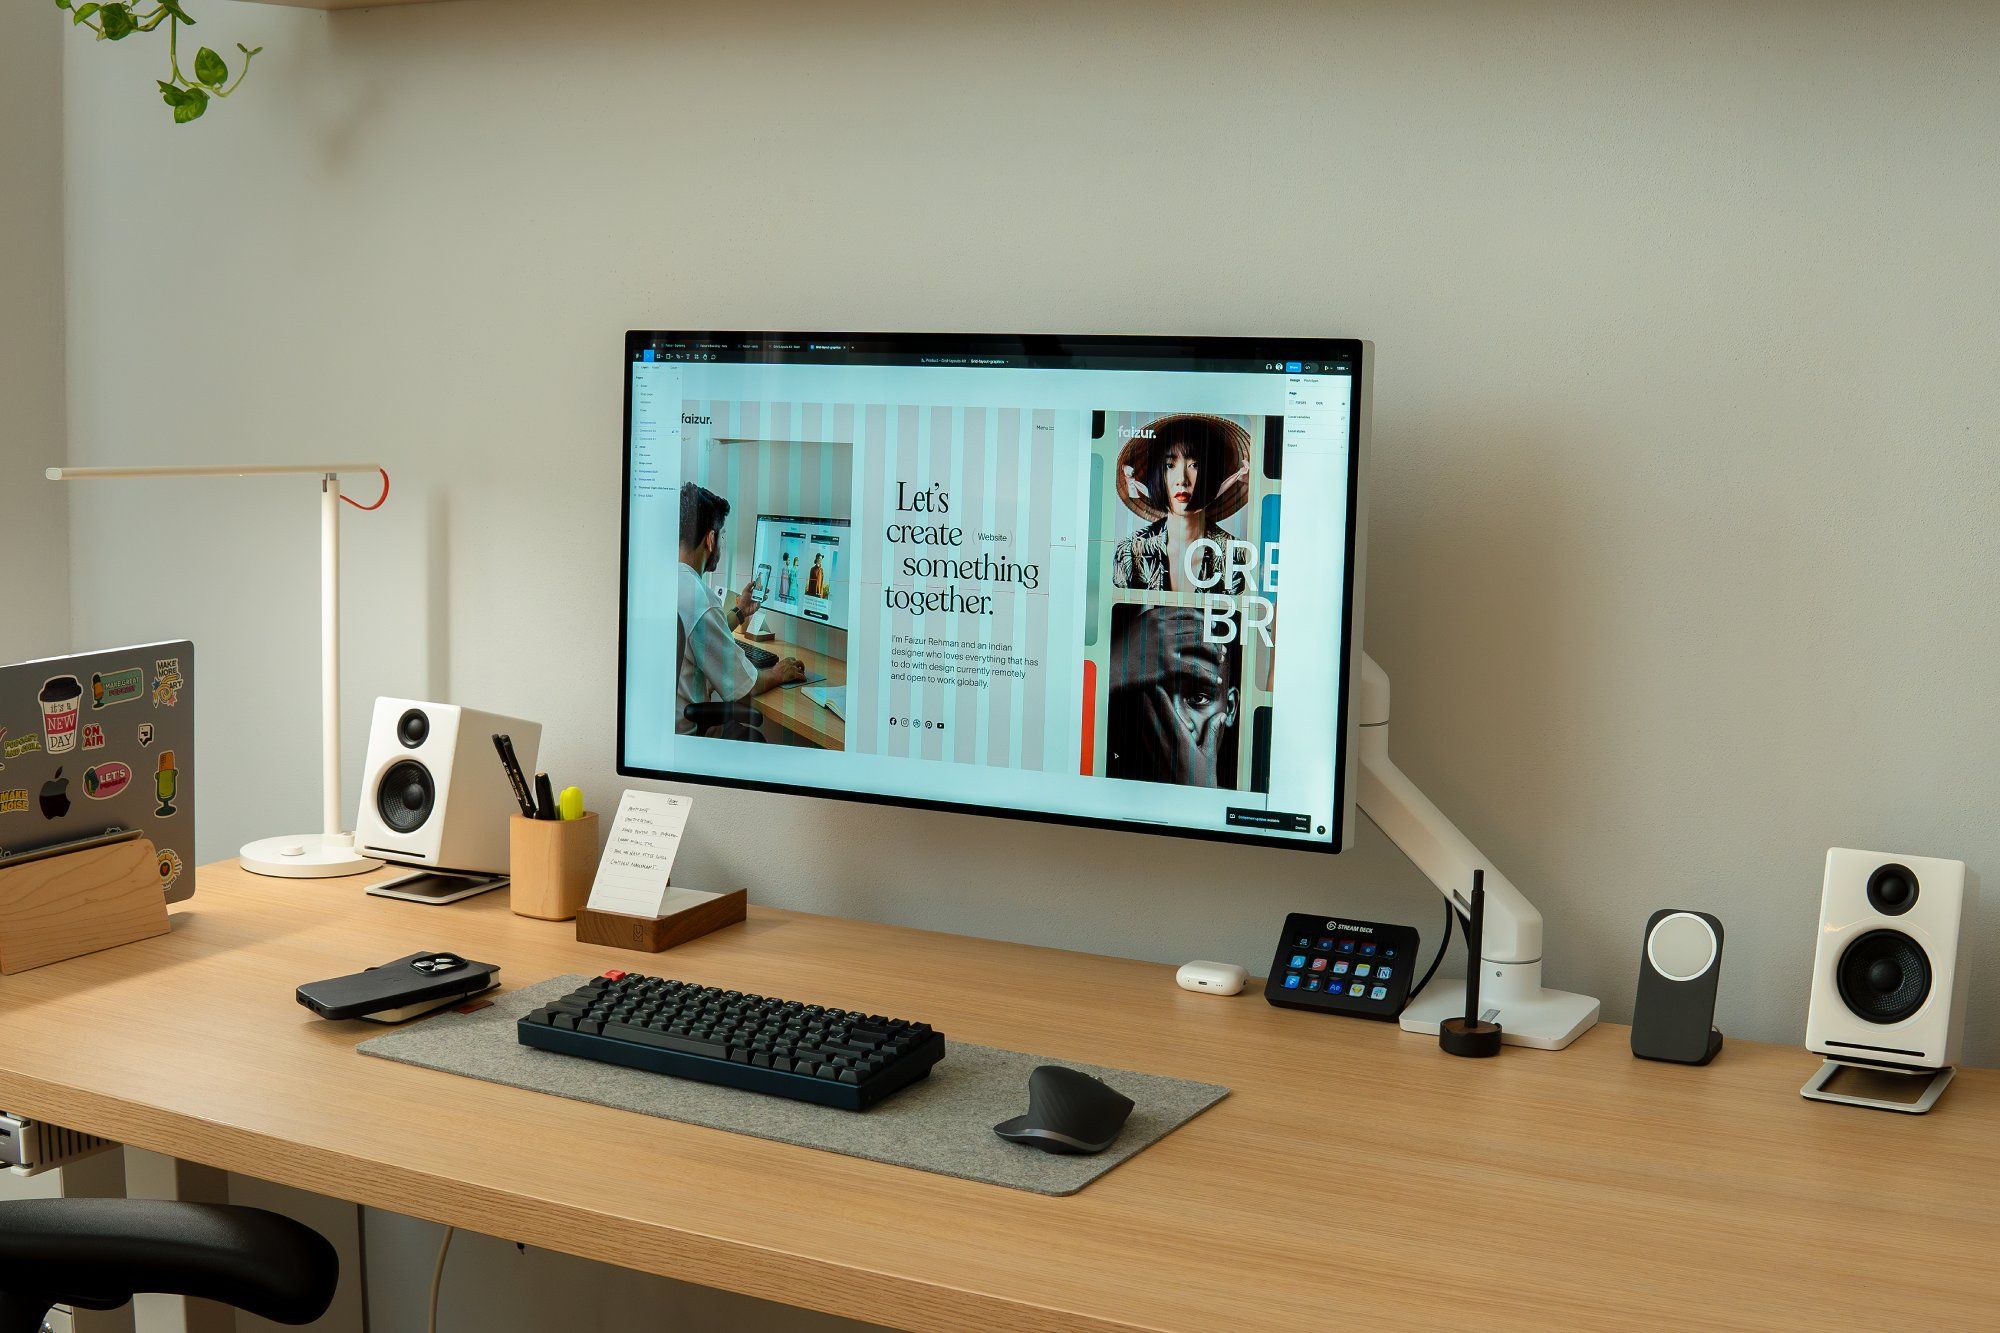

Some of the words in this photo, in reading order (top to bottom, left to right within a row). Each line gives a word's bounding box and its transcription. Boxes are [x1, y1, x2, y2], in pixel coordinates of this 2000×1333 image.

[681, 412, 713, 425] faizur.
[1117, 426, 1157, 439] faizur.
[886, 523, 963, 546] create
[977, 532, 1008, 542] Website
[902, 553, 1039, 589] something
[885, 585, 994, 615] together.
[1203, 593, 1275, 648] BR
[904, 635, 926, 645] Faizur
[928, 637, 960, 648] Rehman
[960, 641, 976, 649] and
[977, 642, 987, 650] an
[988, 642, 1012, 651] Indian
[891, 647, 924, 658] designer
[925, 650, 942, 659] who
[943, 651, 964, 660] loves
[965, 654, 1006, 665] everything
[1007, 656, 1023, 665] that
[1024, 658, 1039, 666] has
[157, 659, 177, 669] MAKE
[891, 660, 899, 668] to
[900, 660, 911, 669] do
[911, 661, 928, 670] with
[928, 662, 955, 674] design
[956, 666, 990, 677] currently
[991, 669, 1026, 680] remotely
[158, 667, 177, 676] MORE
[890, 673, 906, 681] and
[906, 674, 926, 683] open
[927, 675, 936, 683] to
[936, 677, 956, 685] work
[956, 678, 989, 690] globally.
[48, 713, 76, 731] NEW
[84, 726, 100, 737] ON
[50, 733, 74, 749] DAY
[84, 735, 104, 747] AIR
[0, 789, 28, 801] MAKE
[1337, 924, 1359, 932] STREAM
[1329, 983, 1340, 991] Ae
